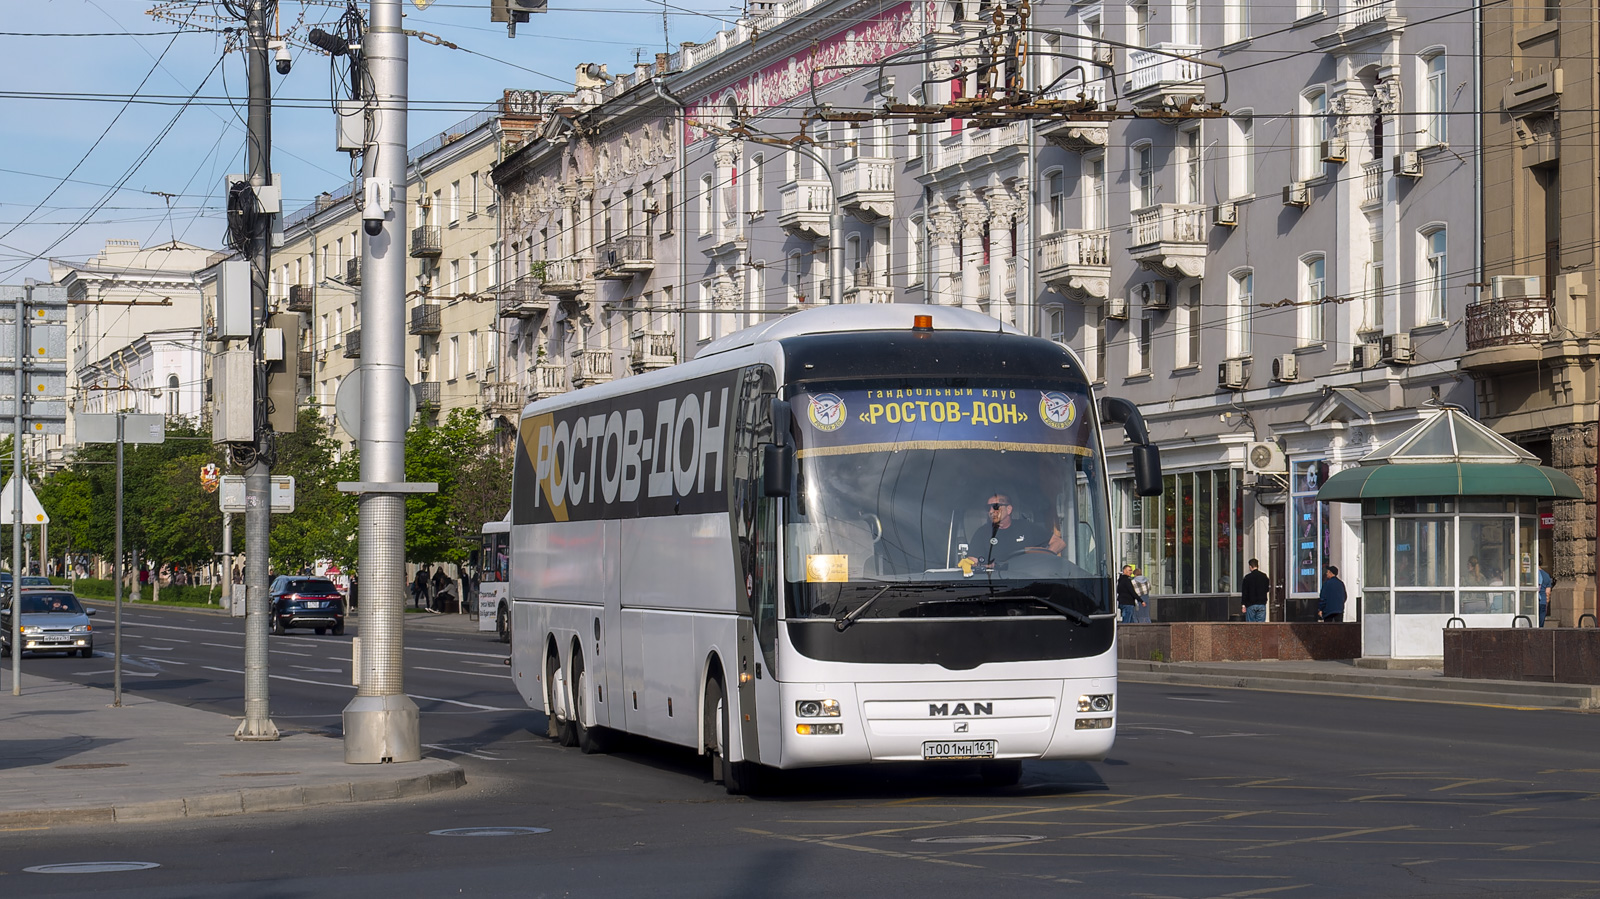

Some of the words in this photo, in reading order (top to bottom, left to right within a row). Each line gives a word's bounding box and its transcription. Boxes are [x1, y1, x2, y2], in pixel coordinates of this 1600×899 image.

[867, 388, 973, 399] гандбольный
[982, 389, 1016, 400] клуб
[858, 401, 1029, 426] «РОСТОВ-ДОН»
[534, 387, 729, 508] РОСТОВ-ДОН
[929, 702, 993, 716] MAN
[929, 743, 972, 755] Т001МН
[974, 742, 991, 751] 161
